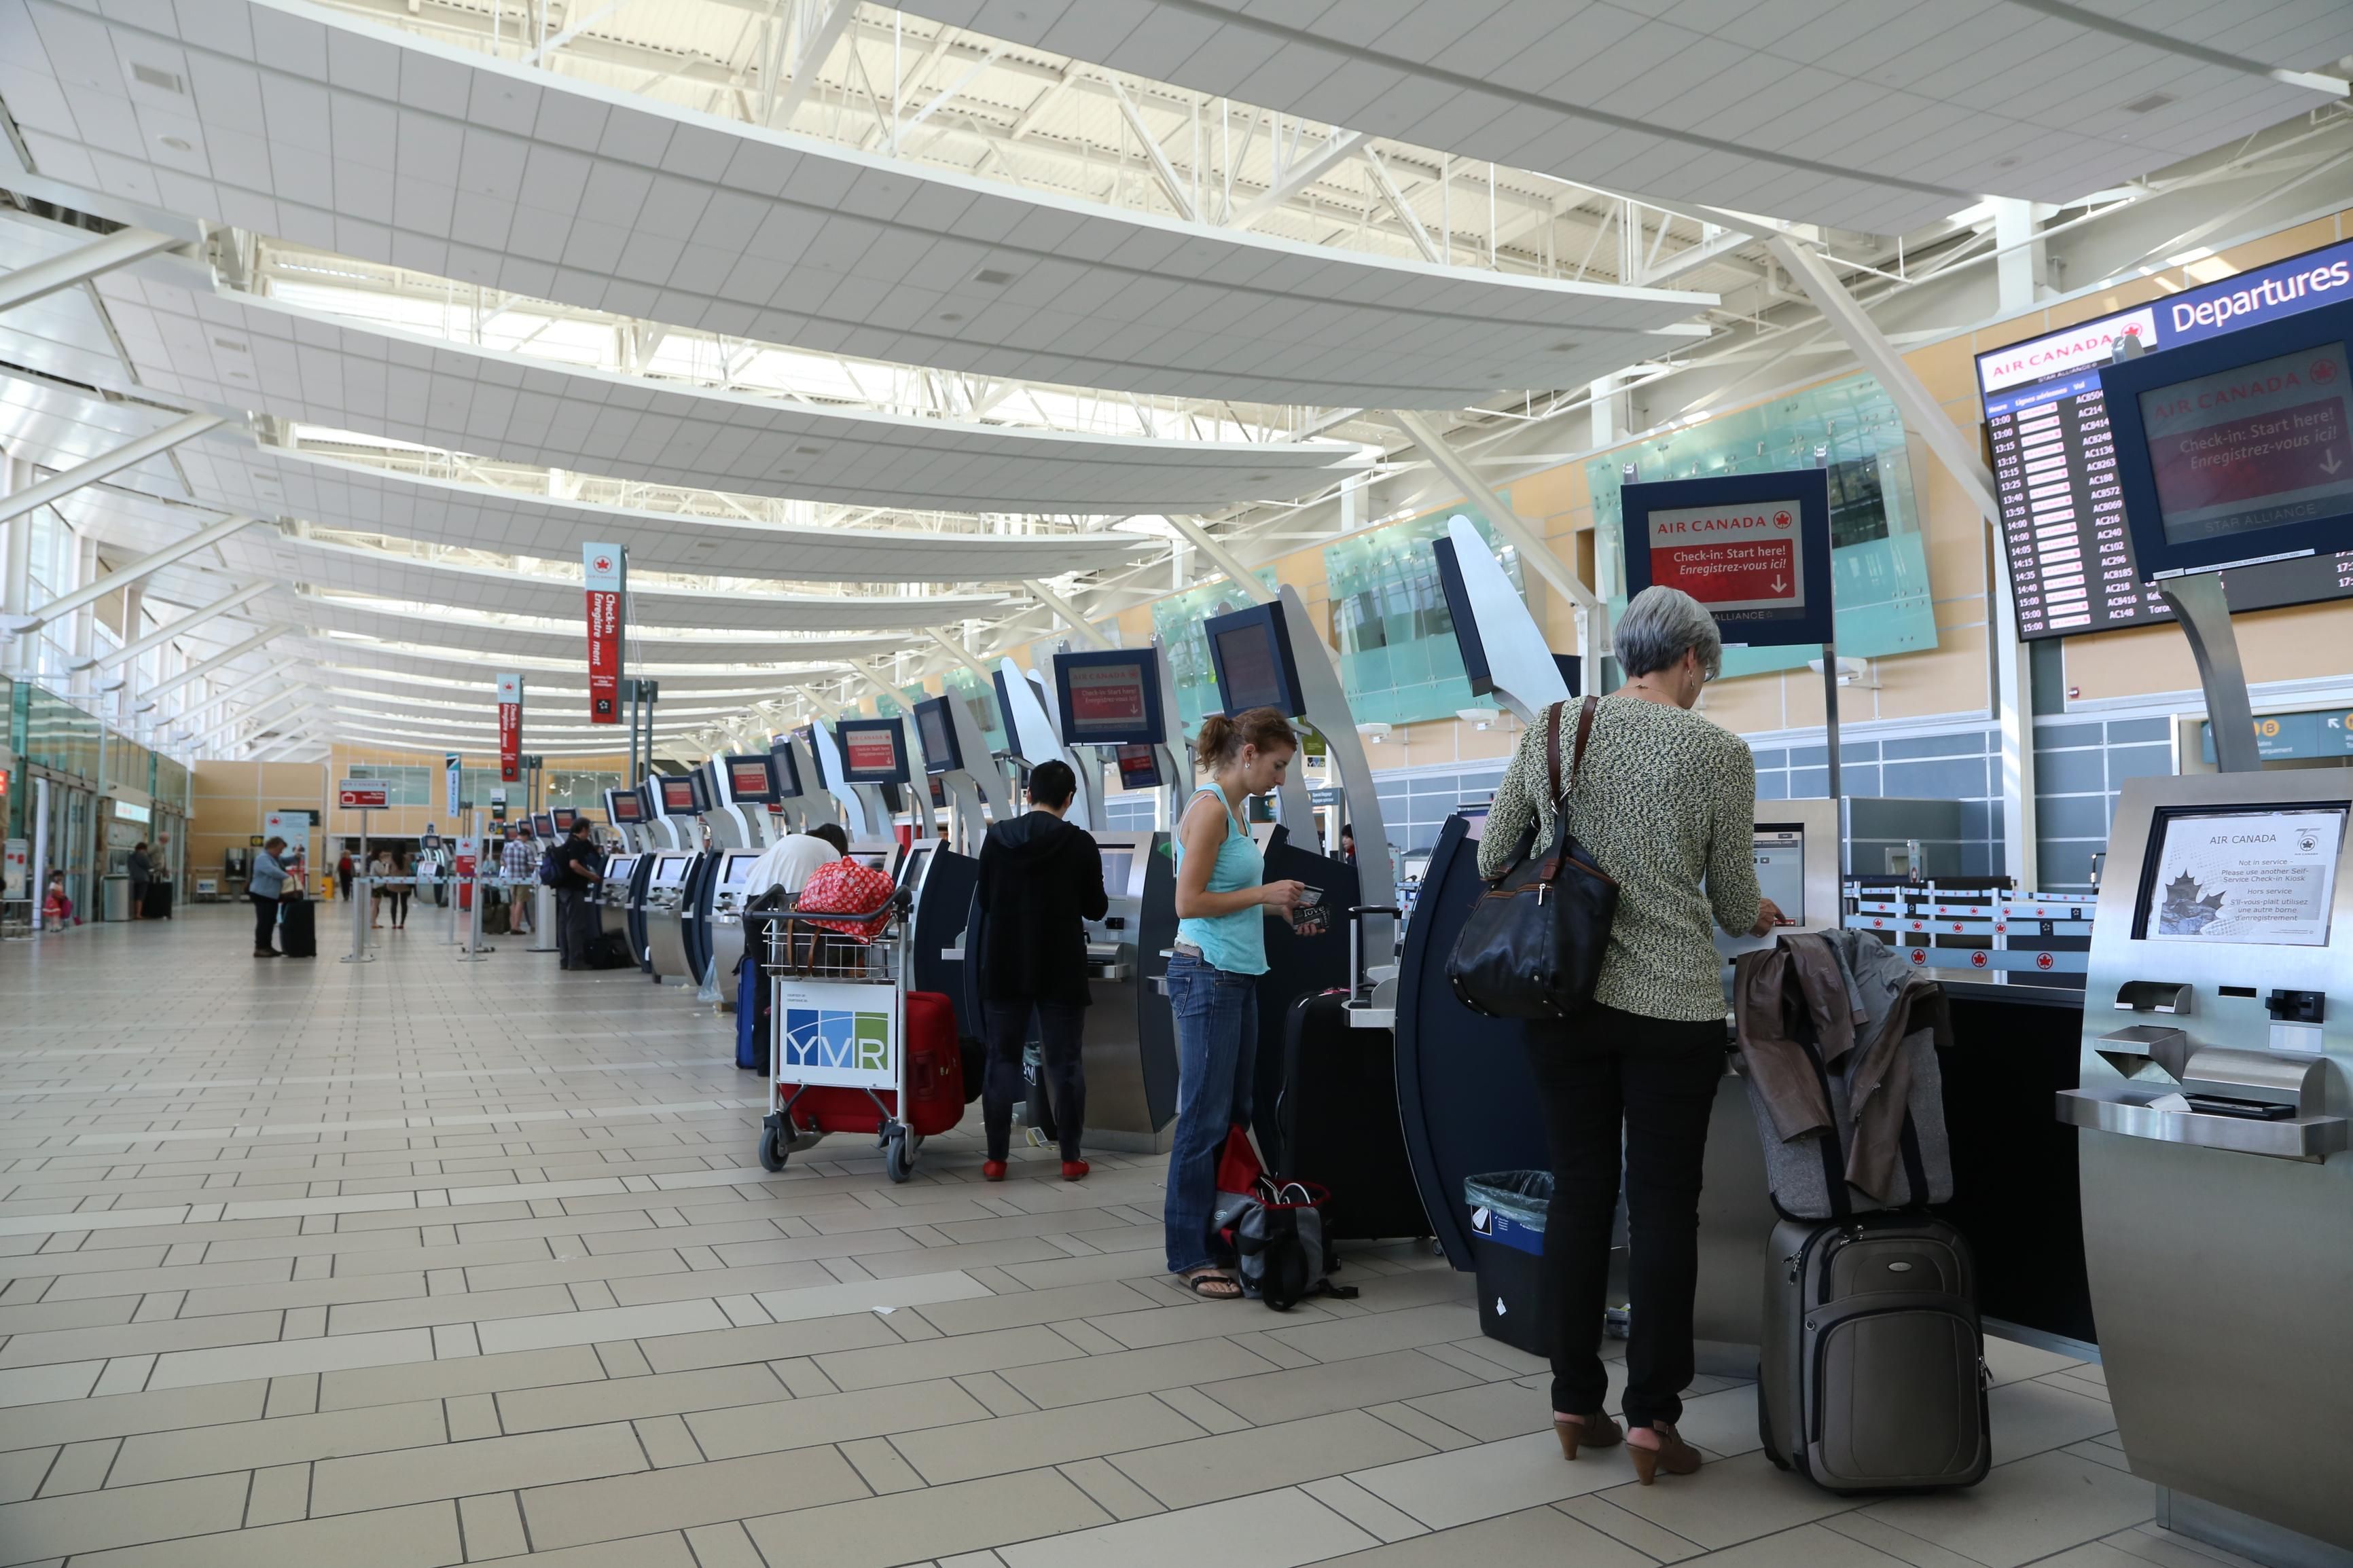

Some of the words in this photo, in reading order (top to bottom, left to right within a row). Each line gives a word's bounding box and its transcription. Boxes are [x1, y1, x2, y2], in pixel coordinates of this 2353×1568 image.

[2172, 261, 2350, 333] Departures
[1993, 361, 2024, 378] AIR
[2030, 334, 2113, 366] CANADA
[2155, 399, 2192, 420] AIR
[2198, 372, 2301, 410] CANADA
[1991, 415, 2011, 426] 13:00
[1993, 428, 2013, 440] 13:00
[2078, 405, 2103, 418] AC214
[2180, 429, 2246, 454] Check-in:
[2250, 418, 2289, 439] Start
[2293, 407, 2335, 428] here!
[1995, 441, 2015, 453] 13:15
[2191, 435, 2310, 469] Enregistrez-vous
[2314, 426, 2338, 443] ici!
[1998, 455, 2017, 467] 13:15
[2000, 467, 2019, 479] 13:15
[2085, 445, 2114, 459] AC1136
[2002, 479, 2022, 491] 13:25
[2004, 493, 2023, 505] 13:40
[2006, 506, 2026, 517] 13:55
[1657, 522, 1686, 534] AIR
[1692, 516, 1766, 532] CANADA
[2007, 519, 2027, 530] 14:00
[2206, 517, 2240, 533] STAR
[2244, 505, 2317, 526] ALLIANCE
[2009, 532, 2029, 543] 14:00
[2095, 514, 2120, 526] AC216
[1674, 549, 1723, 562] Check-in:
[1727, 548, 1755, 559] Start
[1758, 545, 1785, 556] here!
[2012, 545, 2032, 555] 14:05
[1680, 562, 1767, 577] Enregistrez-vous
[1770, 559, 1786, 569] ici!
[2013, 558, 2033, 568] 14:15
[2016, 570, 2035, 581] 14:35
[2017, 583, 2037, 594] 14:40
[2019, 597, 2039, 607] 15:00
[605, 594, 615, 634] Check-in
[1714, 611, 1765, 621] ALLIANCE
[2022, 610, 2041, 620] 15:00
[2024, 622, 2043, 632] 15:00
[2266, 723, 2275, 733] B
[1308, 759, 1325, 767] YVR
[2210, 836, 2227, 844] AIR
[2231, 835, 2276, 843] CANADA
[1304, 906, 1325, 917] love
[787, 1032, 884, 1071] YVR
